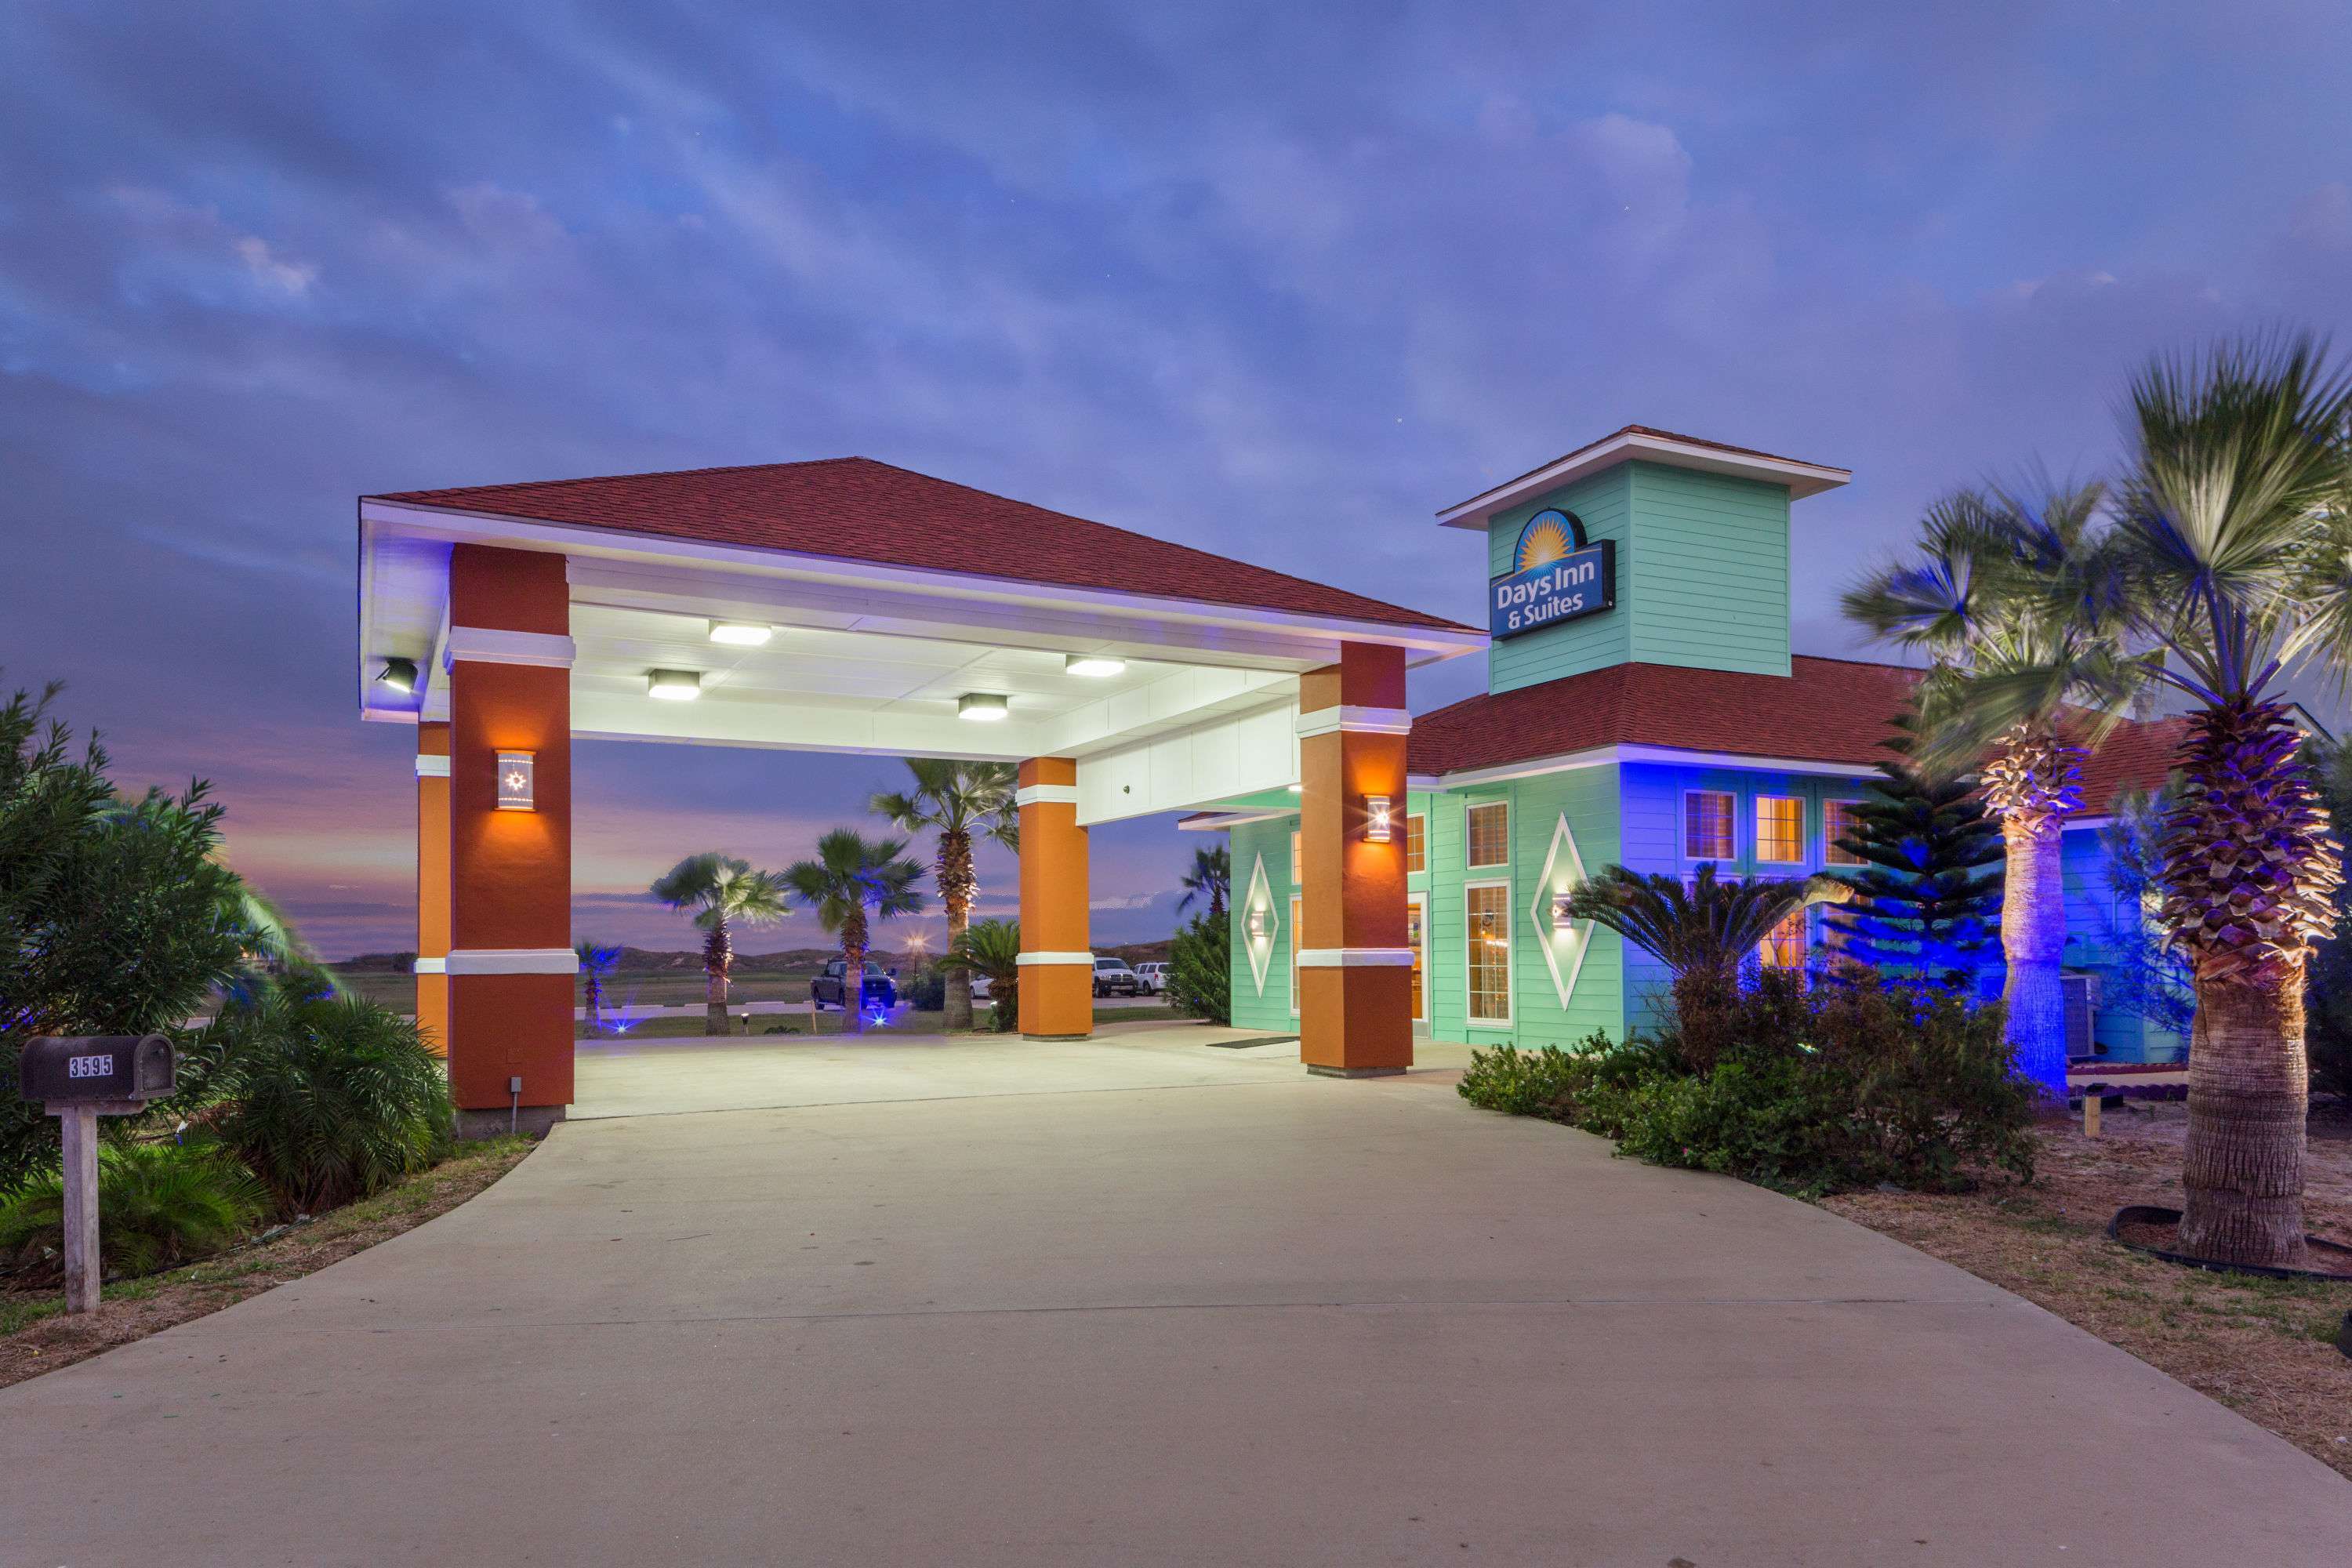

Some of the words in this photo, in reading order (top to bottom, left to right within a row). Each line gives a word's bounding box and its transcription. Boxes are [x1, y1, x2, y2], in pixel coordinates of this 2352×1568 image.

[1497, 575, 1552, 609] Days
[1555, 561, 1595, 590] Inn
[1508, 610, 1520, 630] &
[1524, 593, 1584, 626] Suites
[71, 1056, 111, 1076] 3595
